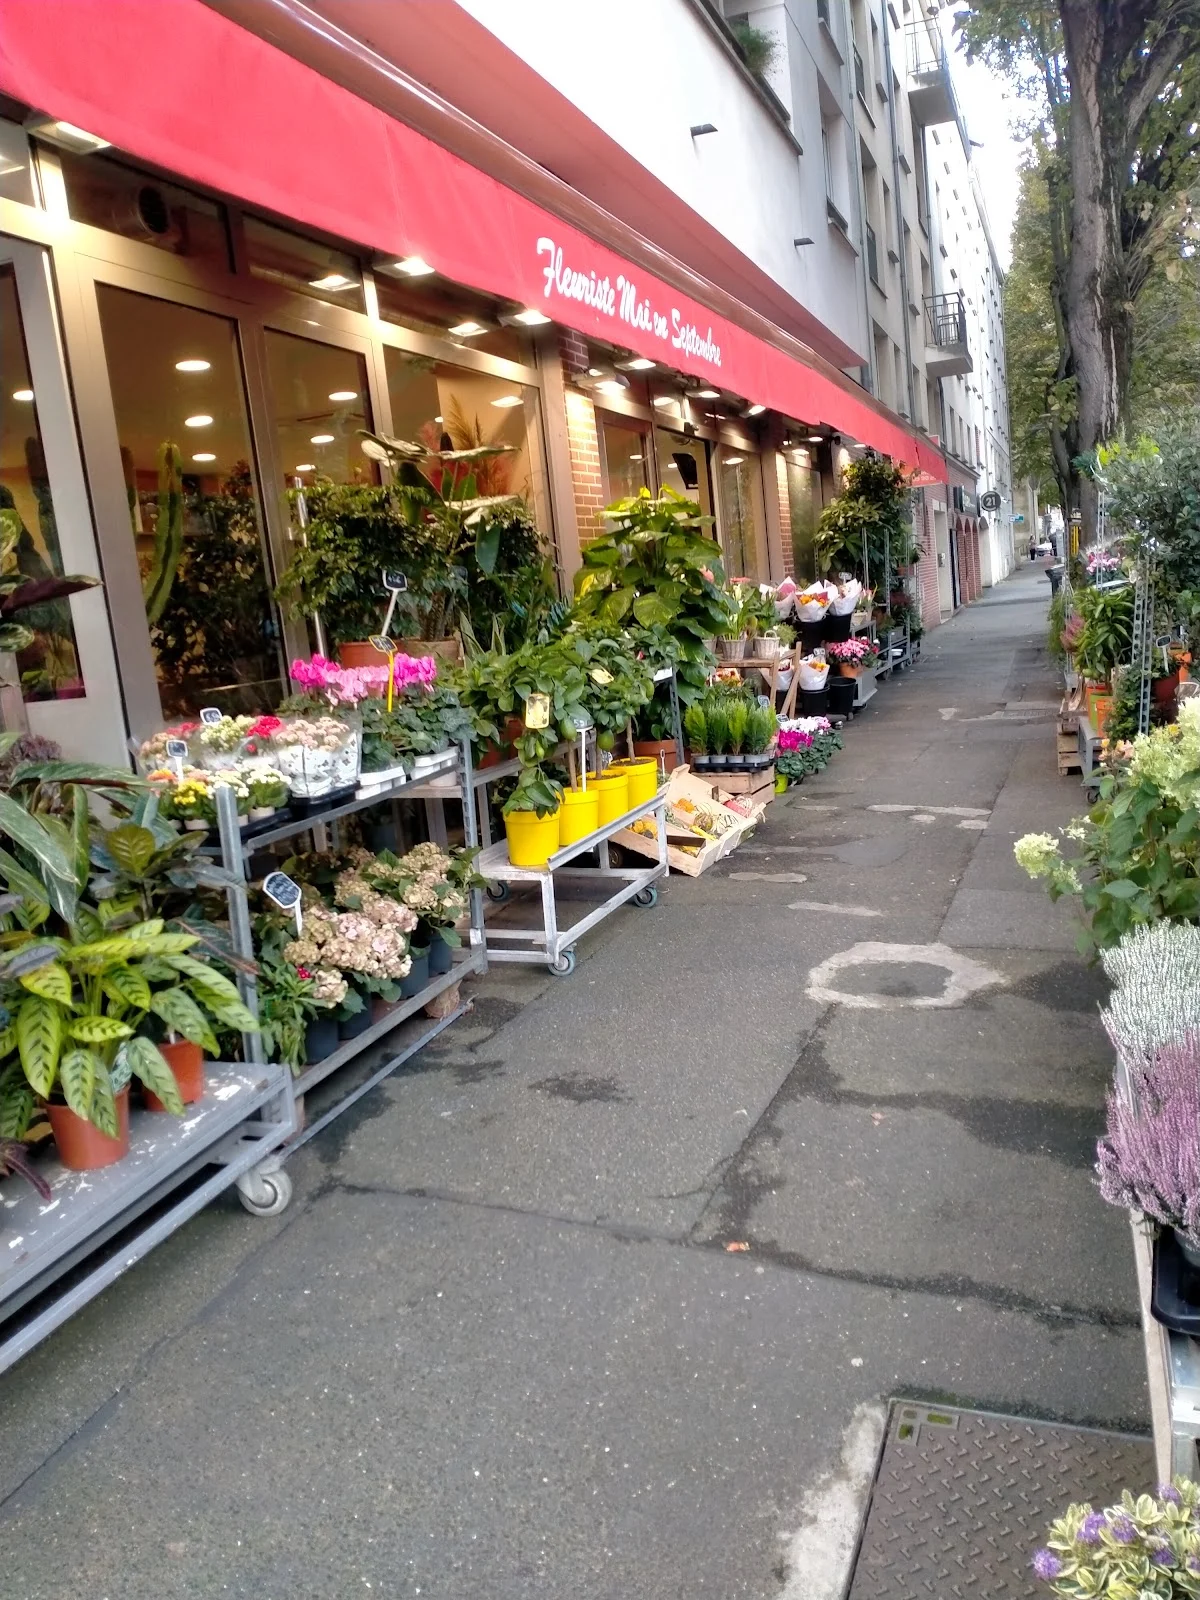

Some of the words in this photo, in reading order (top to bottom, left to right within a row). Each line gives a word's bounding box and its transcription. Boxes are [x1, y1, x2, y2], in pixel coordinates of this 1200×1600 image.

[536, 237, 616, 317] Fleuriste
[616, 274, 653, 331] Mai
[653, 310, 669, 340] en
[671, 307, 722, 368] Septembre
[985, 496, 996, 507] 21
